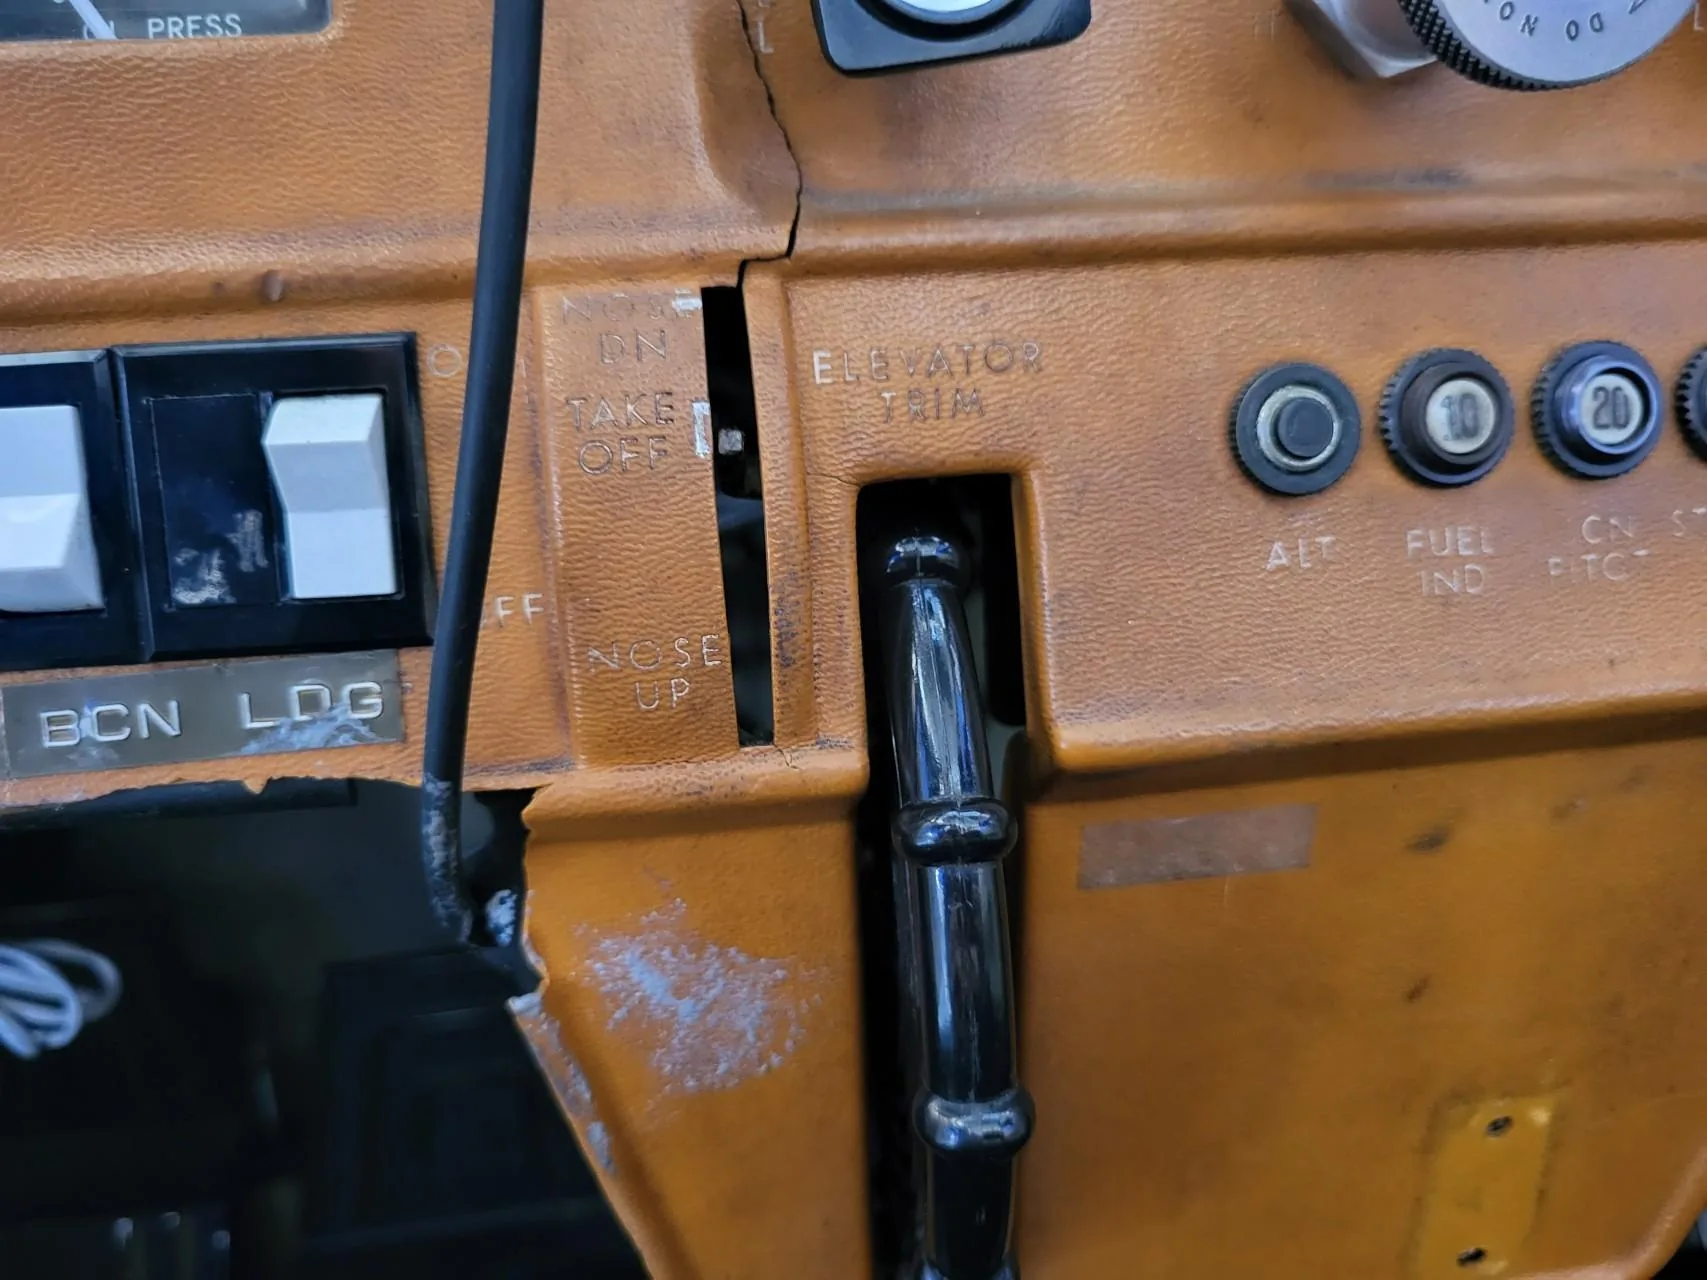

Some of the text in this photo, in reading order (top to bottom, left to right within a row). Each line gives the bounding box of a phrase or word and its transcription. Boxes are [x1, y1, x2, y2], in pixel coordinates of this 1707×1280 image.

[147, 14, 243, 39] PRESS
[1483, 0, 1540, 36] NO
[599, 329, 668, 365] DN
[812, 342, 1043, 385] ELEVATOR
[565, 391, 675, 432] TAKE
[880, 387, 985, 424] TRIM
[1441, 392, 1479, 441] 10
[1593, 386, 1630, 430] 20
[578, 435, 670, 475] OFF
[1266, 535, 1337, 571] ALT
[1406, 526, 1494, 558] FUEL
[1418, 563, 1486, 597] IND
[480, 592, 544, 628] FF
[587, 634, 723, 673] NOSE
[635, 677, 691, 710] UP
[39, 680, 384, 749] BCN LDG
